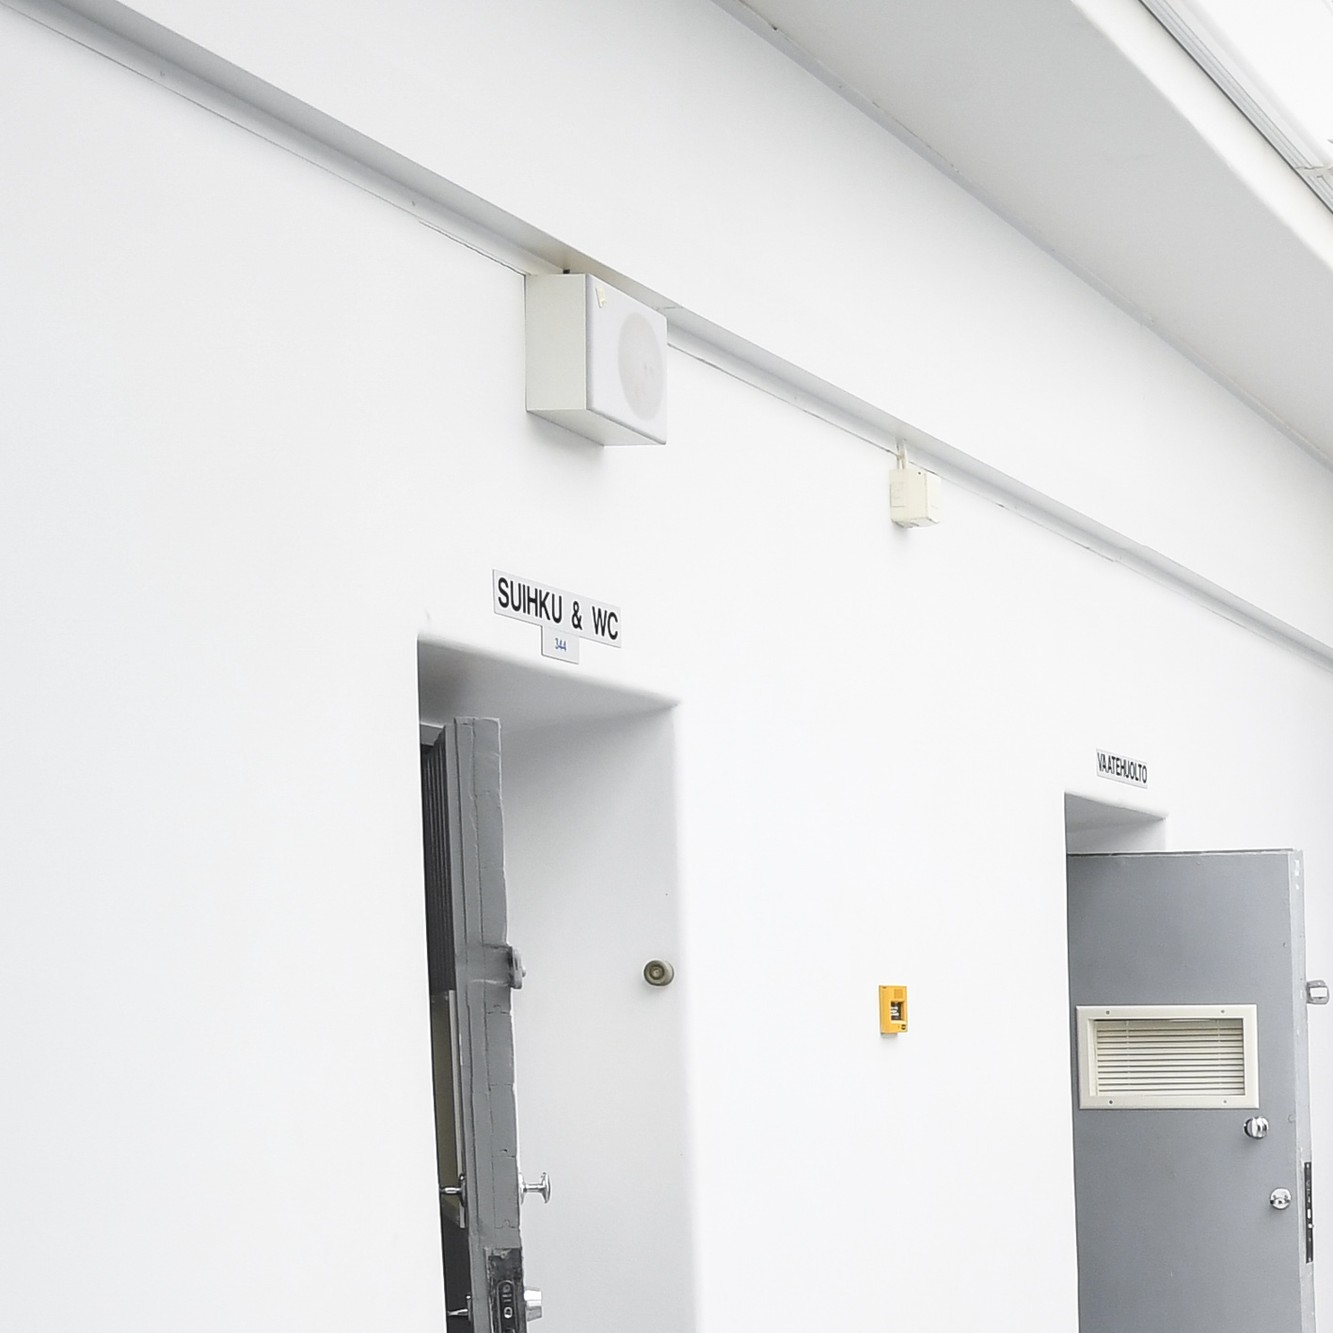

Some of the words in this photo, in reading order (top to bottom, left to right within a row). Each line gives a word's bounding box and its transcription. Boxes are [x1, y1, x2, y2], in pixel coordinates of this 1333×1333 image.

[498, 577, 562, 623] SUIHKU
[572, 601, 582, 630] &
[592, 606, 618, 640] WC
[555, 638, 567, 651] 344
